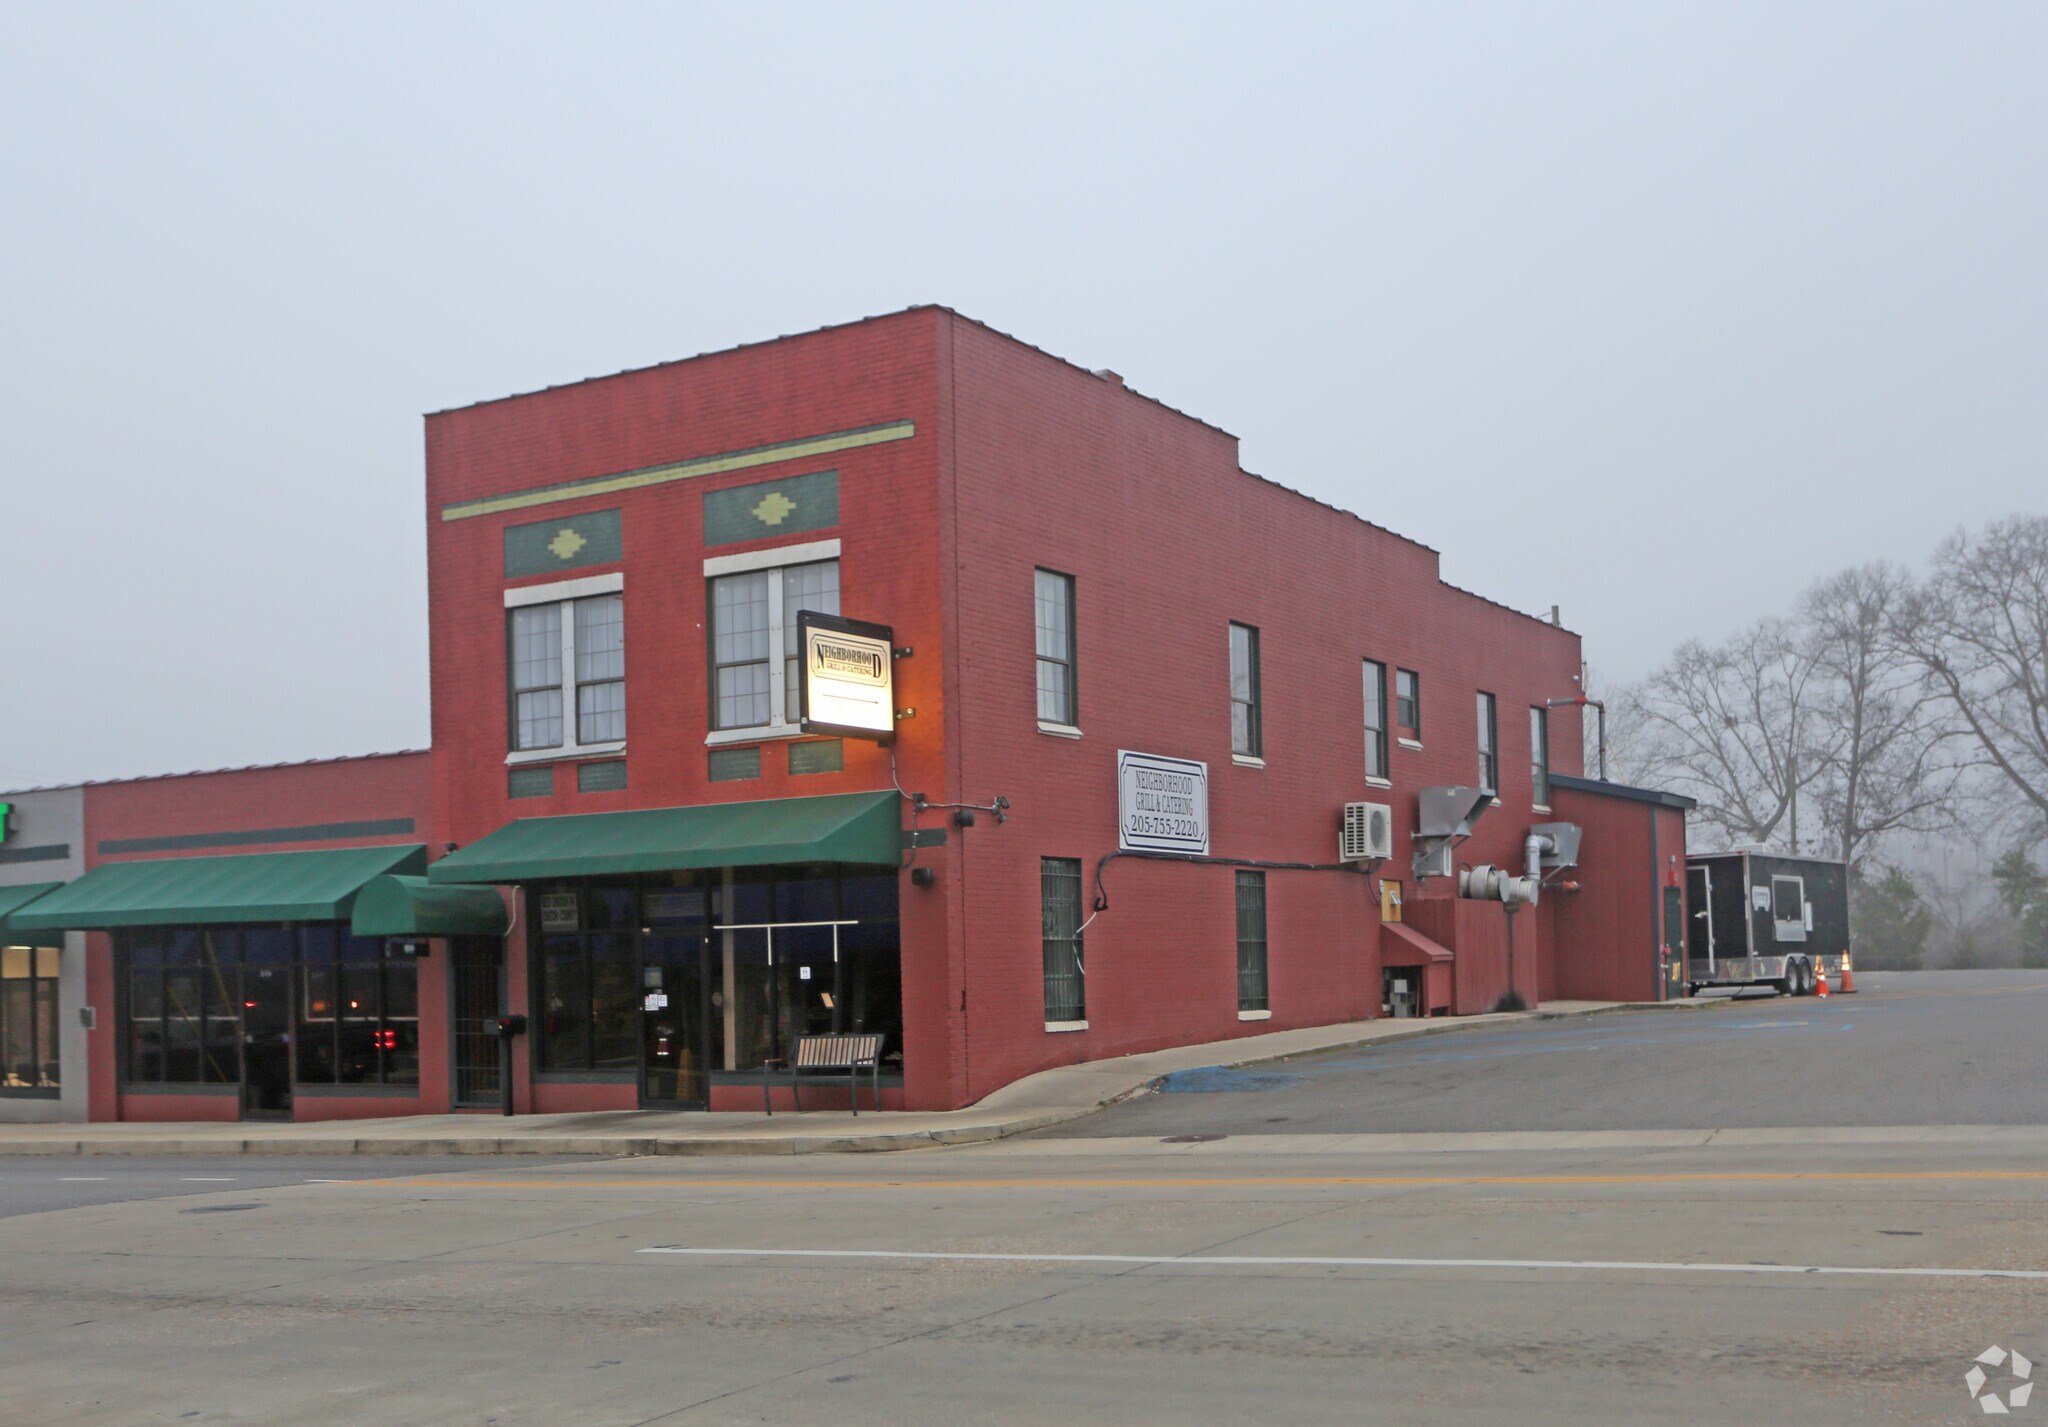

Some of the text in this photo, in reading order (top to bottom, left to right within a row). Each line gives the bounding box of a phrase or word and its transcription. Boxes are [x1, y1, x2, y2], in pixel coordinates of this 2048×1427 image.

[816, 643, 882, 678] NEIGHBORHOOD
[827, 662, 841, 671] GRILL
[847, 666, 872, 676] CATERING
[1135, 770, 1193, 795] NEIGHBORHOOD
[1135, 792, 1193, 816] GRILL & CATERING
[1131, 814, 1199, 837] 205-755-2220
